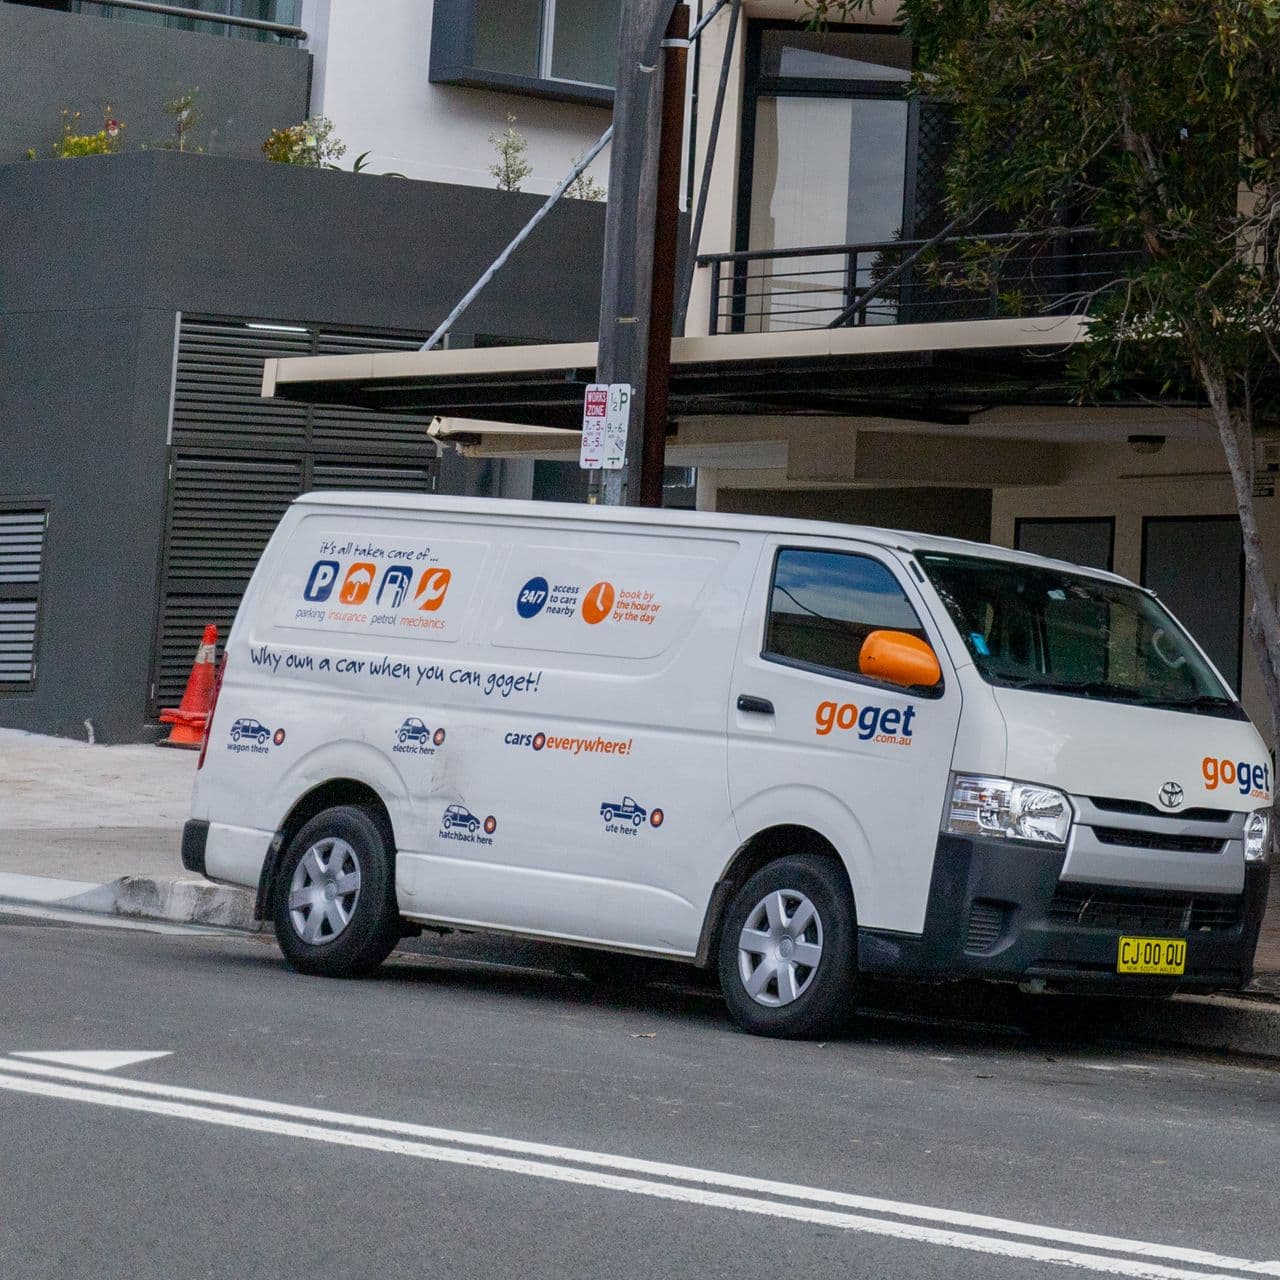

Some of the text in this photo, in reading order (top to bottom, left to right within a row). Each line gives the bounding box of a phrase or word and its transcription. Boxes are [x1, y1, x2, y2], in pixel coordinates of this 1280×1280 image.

[620, 393, 628, 412] P
[587, 405, 605, 416] ZONE
[337, 542, 353, 555] all
[354, 545, 385, 558] taken
[387, 549, 413, 560] care
[552, 584, 579, 594] access
[619, 589, 655, 601] book by
[520, 589, 546, 604] 24/7
[550, 594, 577, 604] to cars
[546, 606, 575, 617] nearby
[616, 600, 661, 612] the hour or
[295, 608, 446, 629] parking insurance petrol mechanics
[613, 610, 656, 624] by the day
[250, 645, 543, 697] Why own a car when you can goget!
[815, 700, 916, 740] goget
[504, 732, 633, 755] cars everywhere!
[872, 734, 913, 746] .com.au
[227, 743, 269, 754] wagon there
[392, 744, 435, 755] electric here
[1202, 756, 1270, 795] goget
[605, 824, 638, 836] ute here
[439, 830, 493, 846] hatchback here
